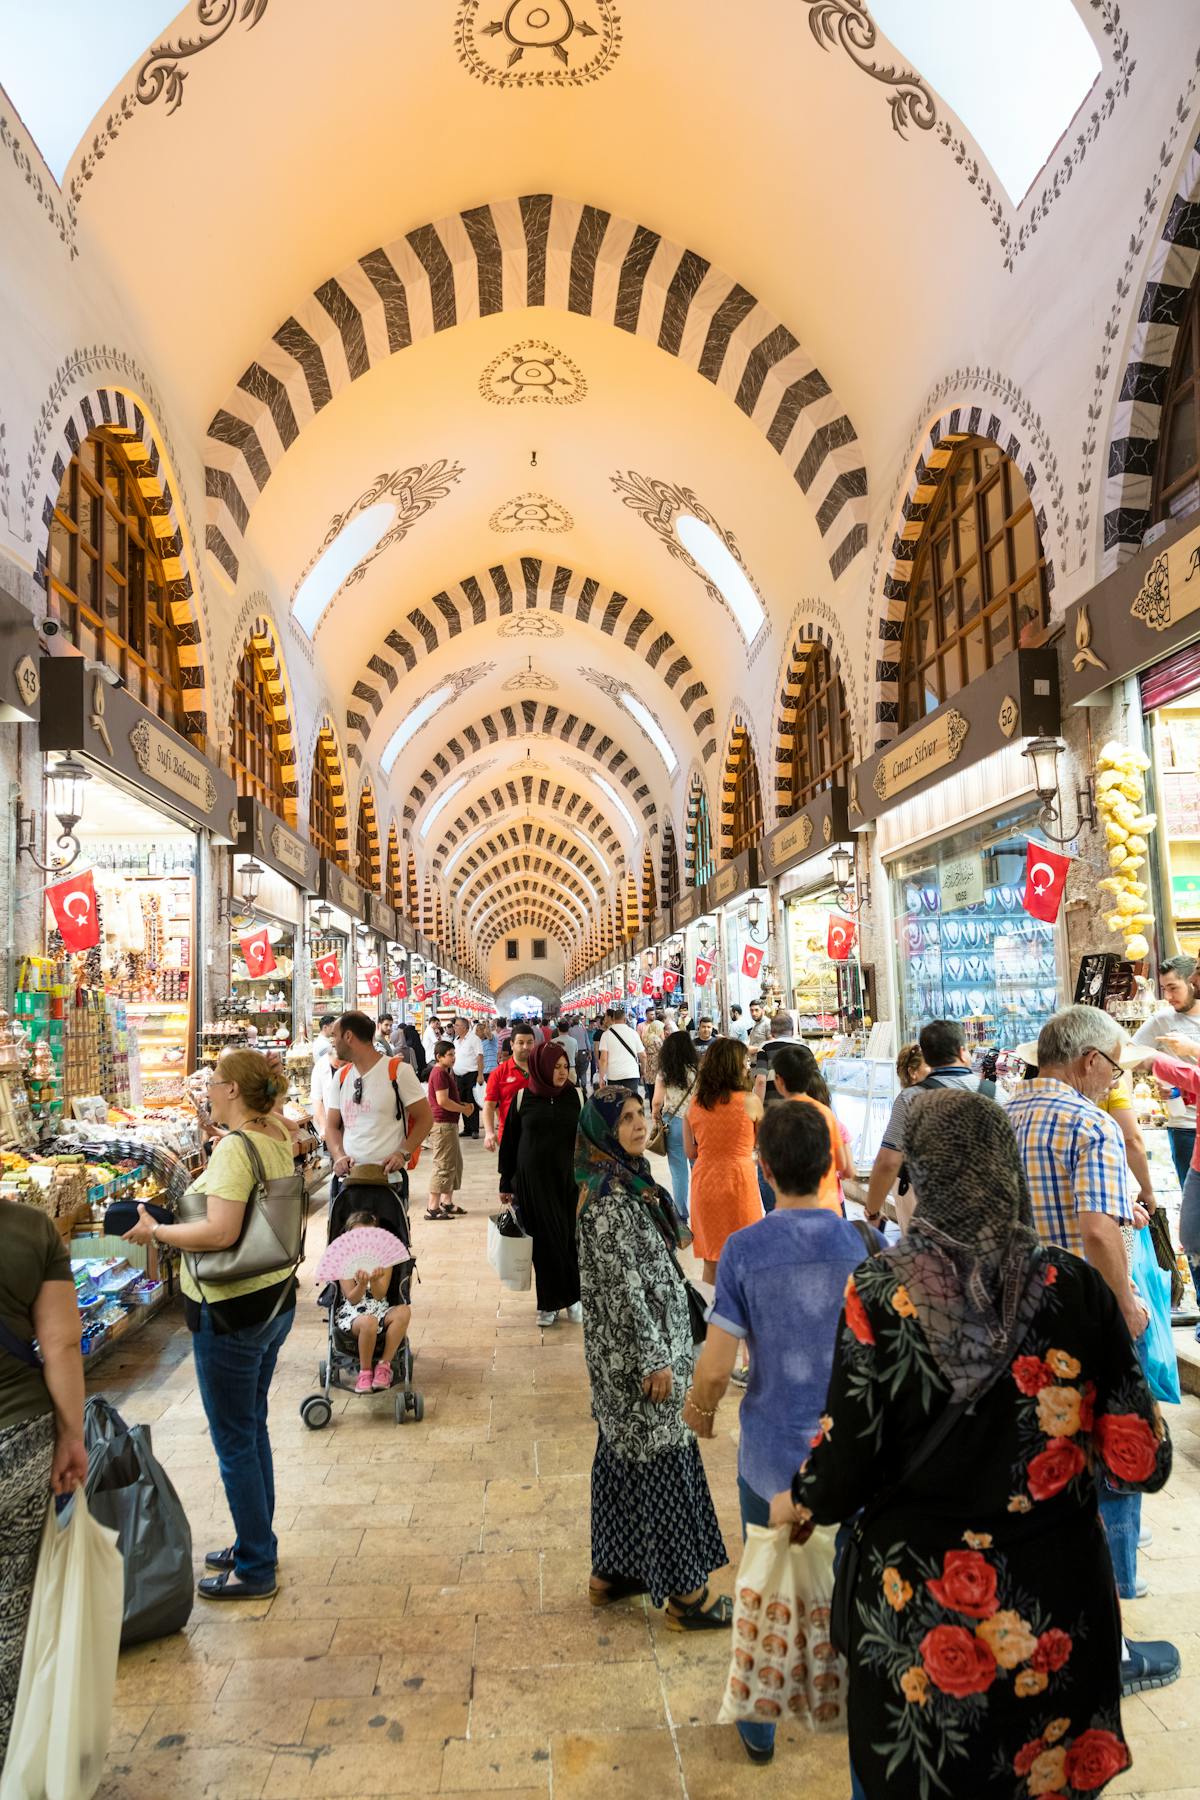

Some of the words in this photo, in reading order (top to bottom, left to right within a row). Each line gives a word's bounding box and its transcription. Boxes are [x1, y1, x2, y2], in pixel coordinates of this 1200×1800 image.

[23, 668, 36, 693] 43
[1001, 706, 1013, 727] 52
[914, 738, 938, 765] Silver
[157, 744, 172, 773] Sufi
[173, 756, 201, 790] Baharat
